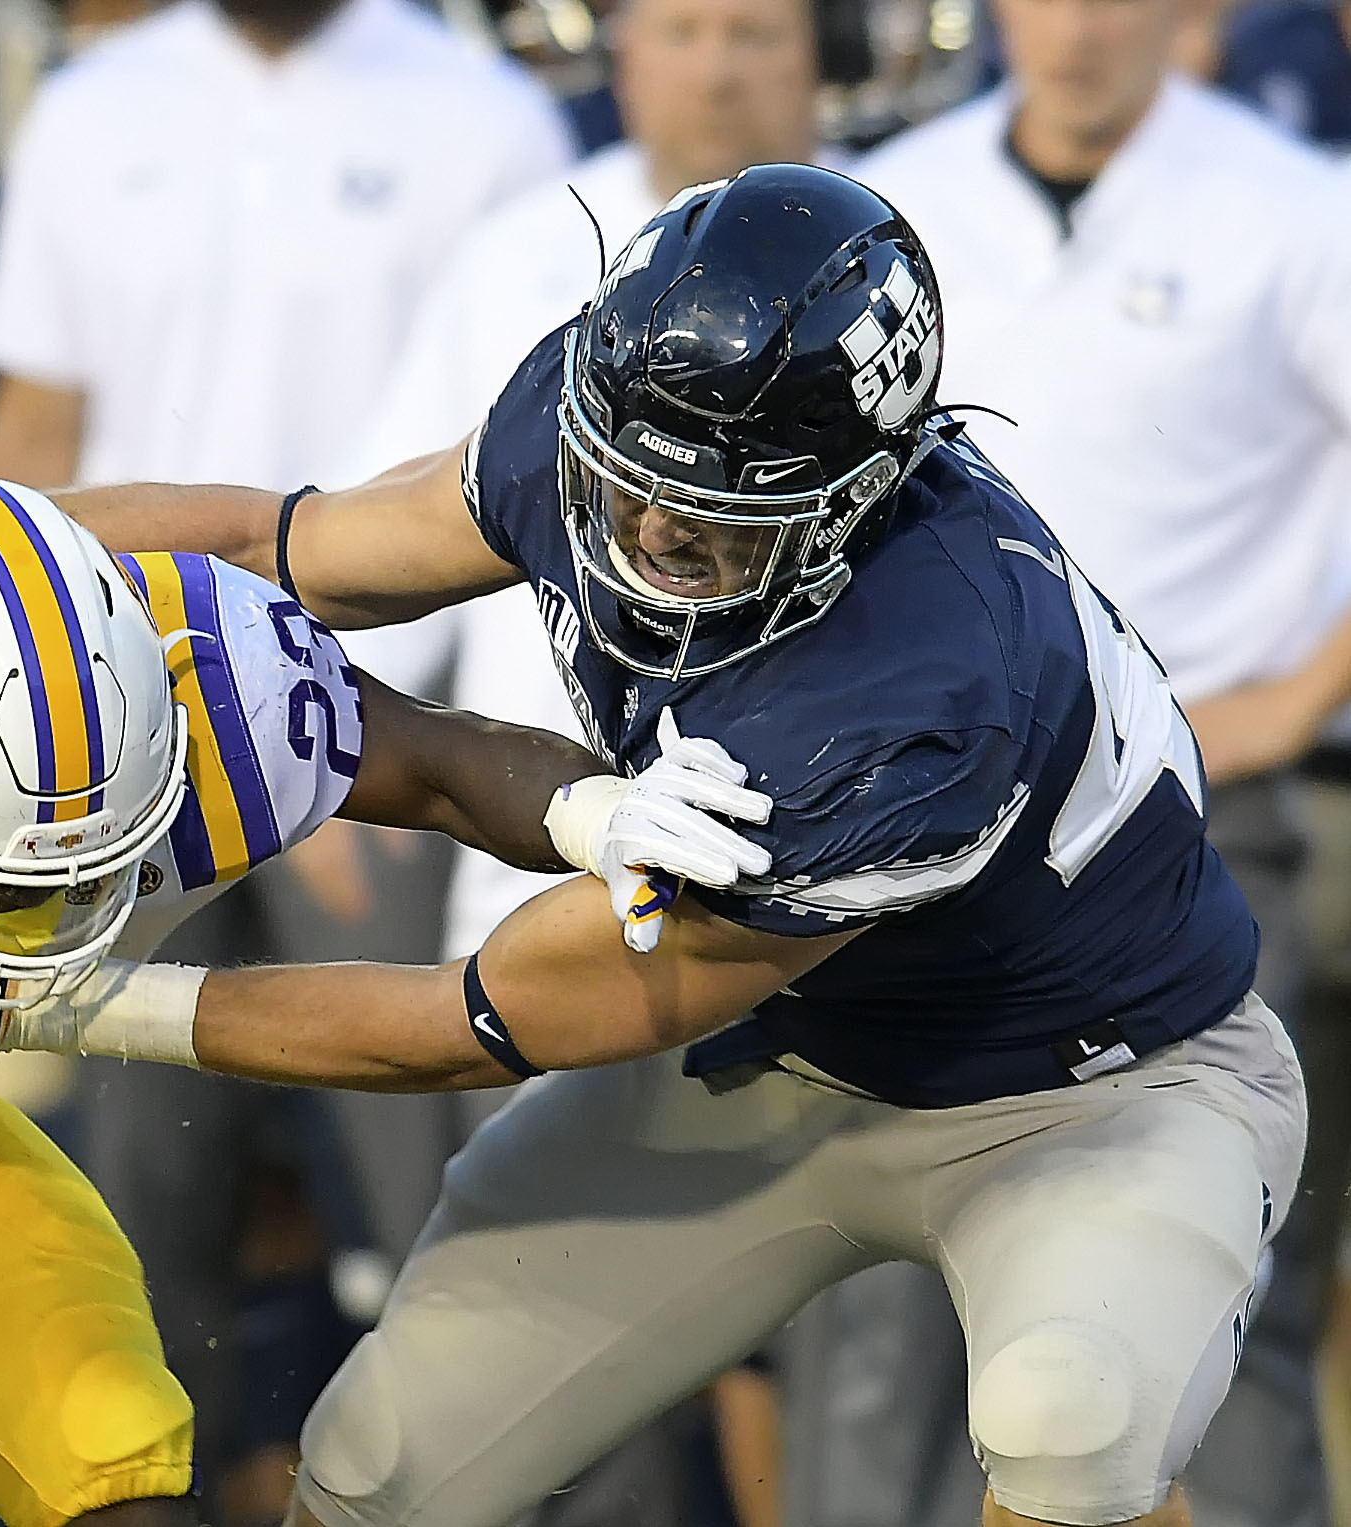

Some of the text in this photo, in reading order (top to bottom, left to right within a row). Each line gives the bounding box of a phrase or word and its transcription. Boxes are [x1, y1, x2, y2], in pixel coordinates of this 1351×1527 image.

[851, 286, 937, 415] STATE
[637, 430, 698, 465] AGGIES
[632, 607, 674, 633] Riddell
[1077, 1038, 1102, 1056] L
